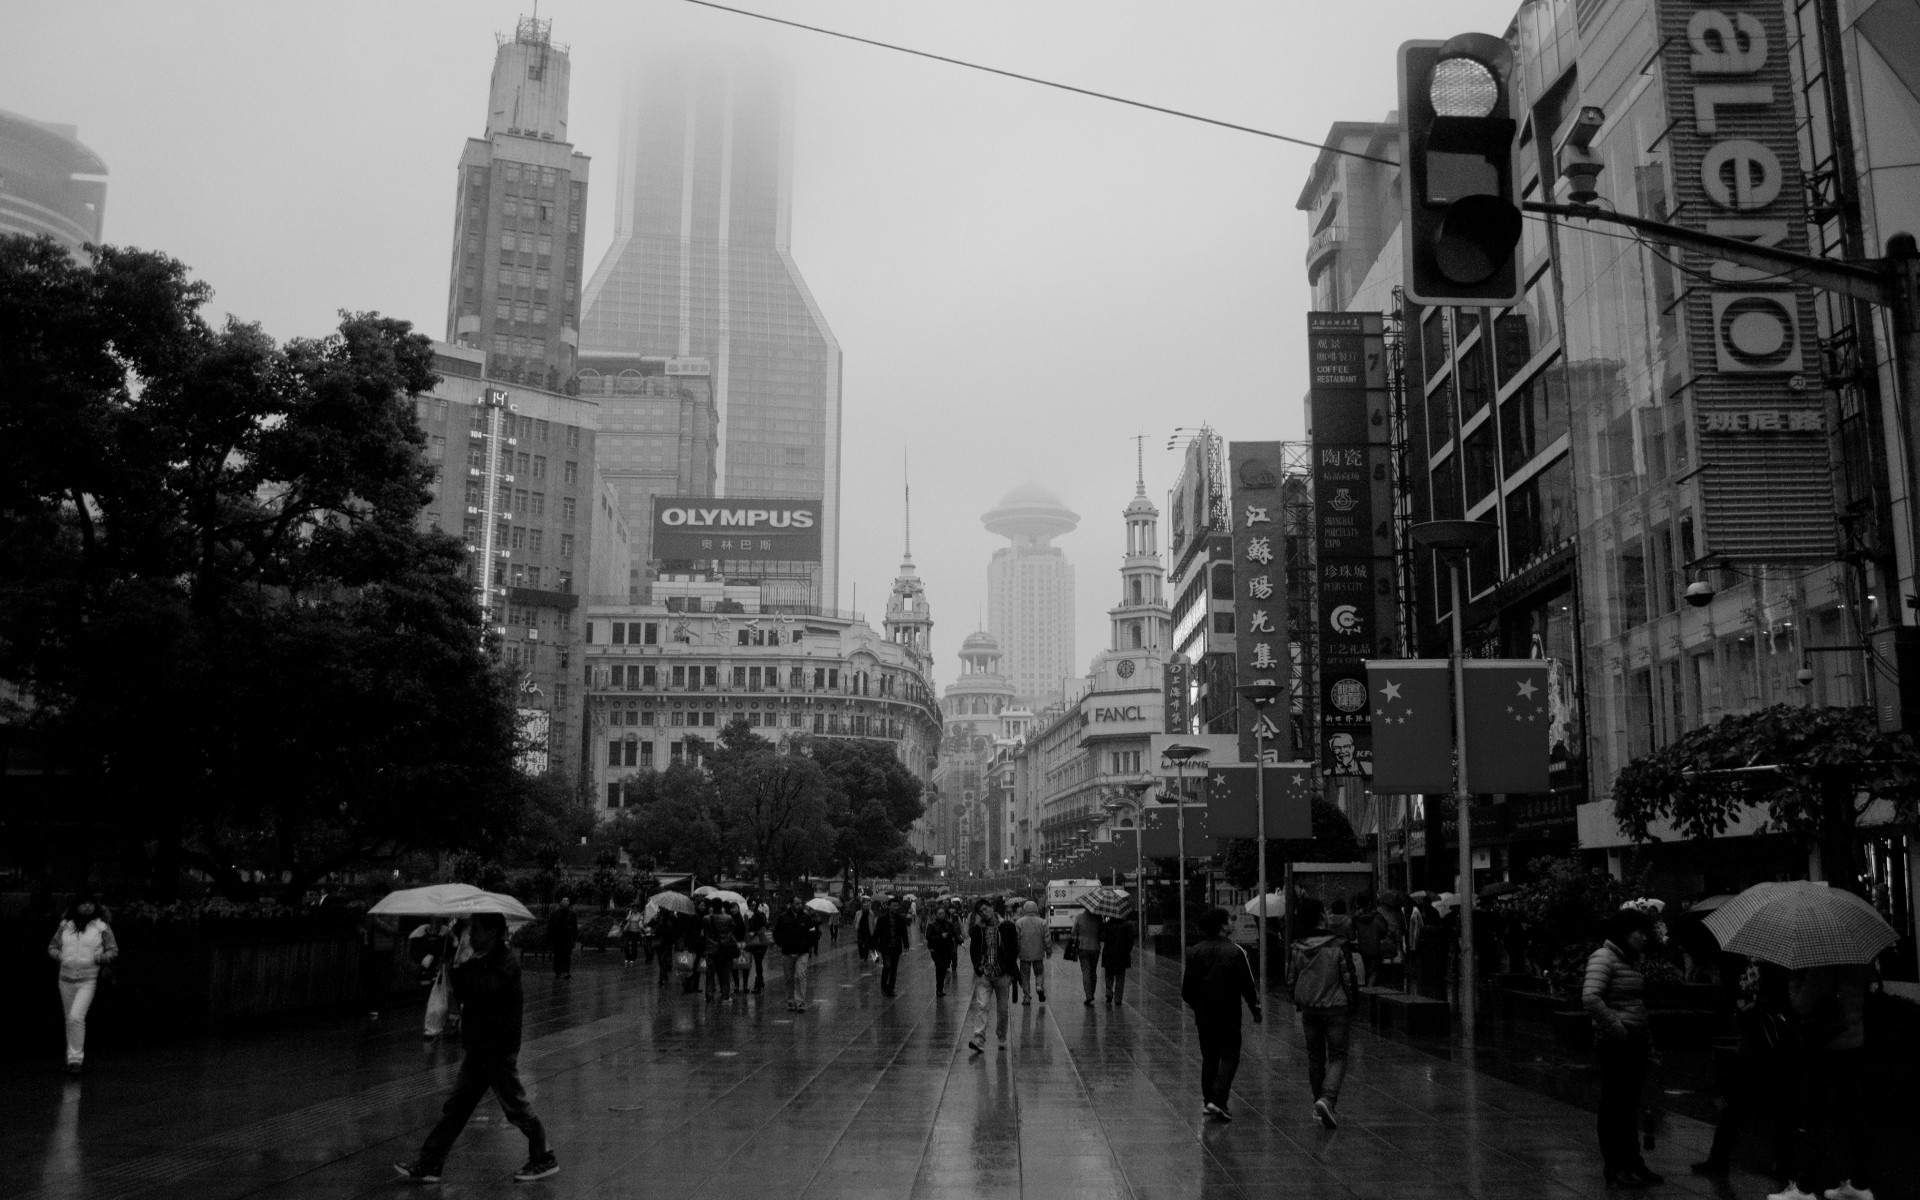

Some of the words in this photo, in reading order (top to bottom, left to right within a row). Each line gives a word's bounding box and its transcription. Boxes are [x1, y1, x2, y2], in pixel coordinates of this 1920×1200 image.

[1368, 353, 1379, 370] 7
[1316, 365, 1349, 373] COFFEE
[1316, 375, 1357, 383] RESTAURANT
[1705, 409, 1824, 431] 班尼路
[1322, 449, 1362, 467] 陶瓷
[661, 507, 814, 528] OLYMPUS
[701, 539, 771, 551] 奥林巴斯
[501, 549, 511, 559] 10
[1325, 565, 1368, 578] 珍珠城
[1329, 643, 1371, 655] 工艺礼品
[1095, 705, 1146, 722] FANCL
